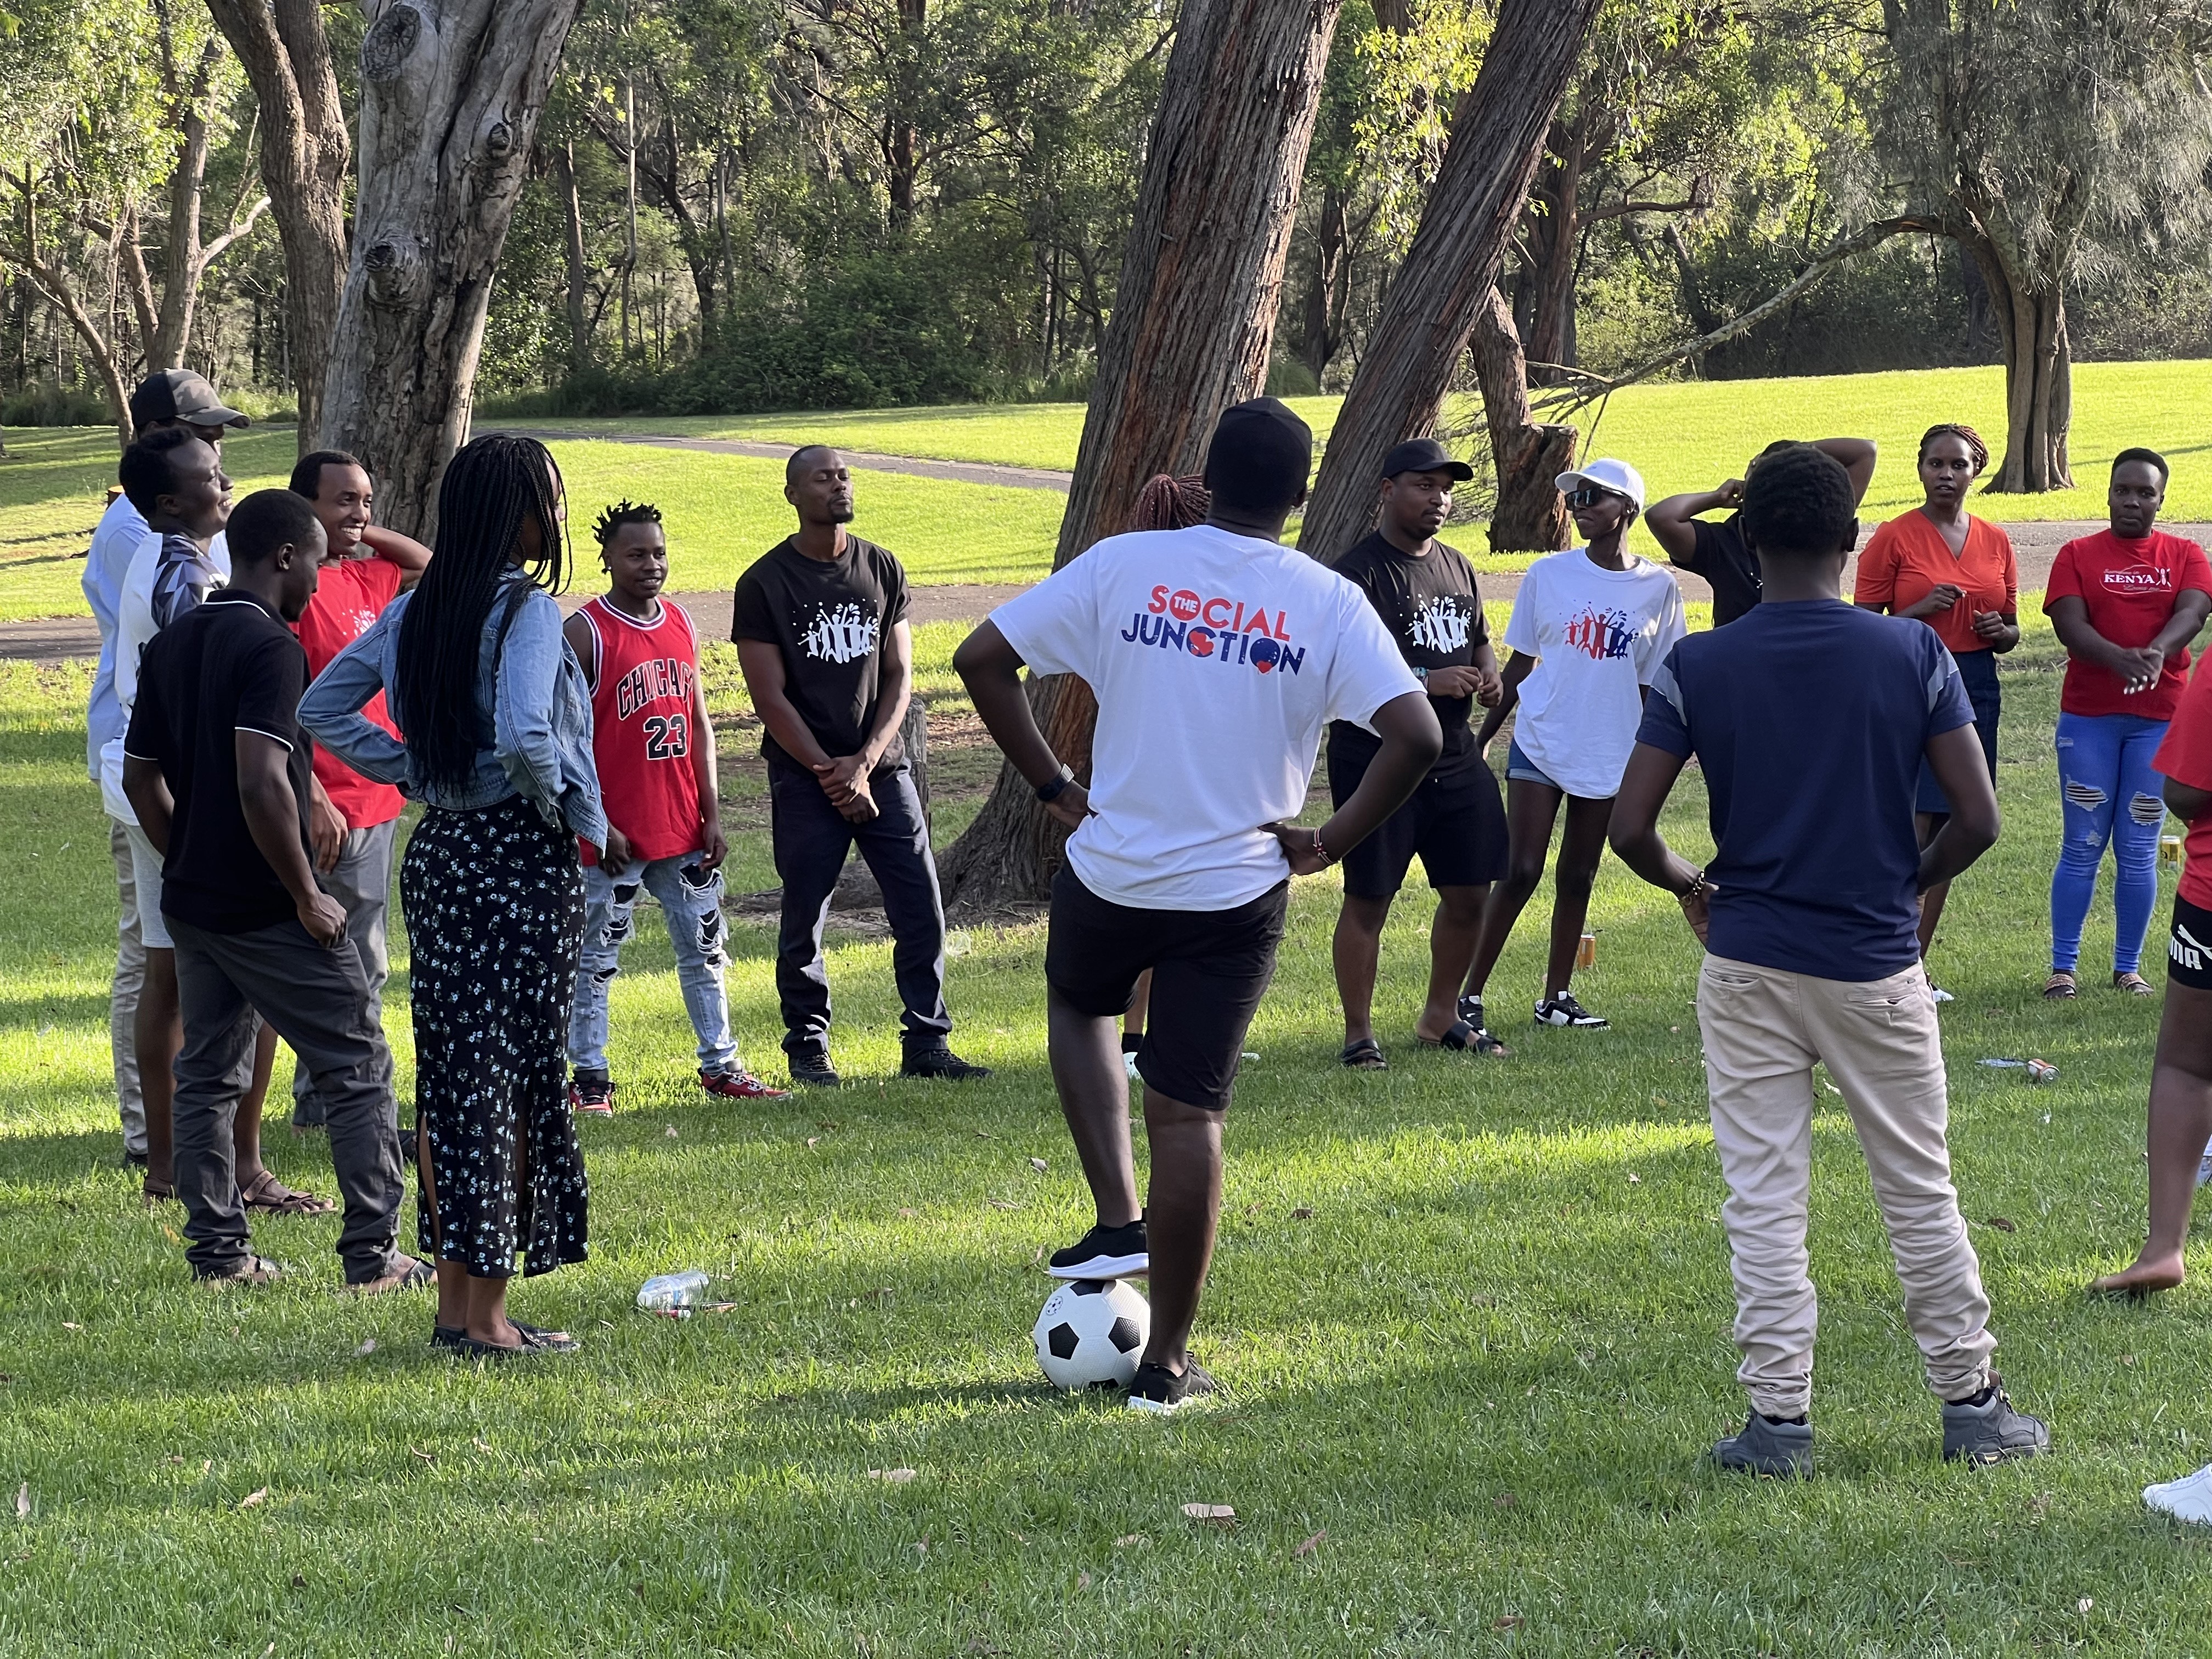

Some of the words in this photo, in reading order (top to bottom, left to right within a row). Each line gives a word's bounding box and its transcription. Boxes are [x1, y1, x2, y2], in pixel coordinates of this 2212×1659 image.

[2104, 574, 2155, 584] KENYA
[1148, 585, 1290, 642] SOCIAL
[1173, 595, 1199, 614] THE
[1121, 613, 1306, 676] JUNCTION
[616, 658, 695, 721] CHICAG
[643, 713, 688, 760] 23
[2170, 935, 2203, 970] MA
